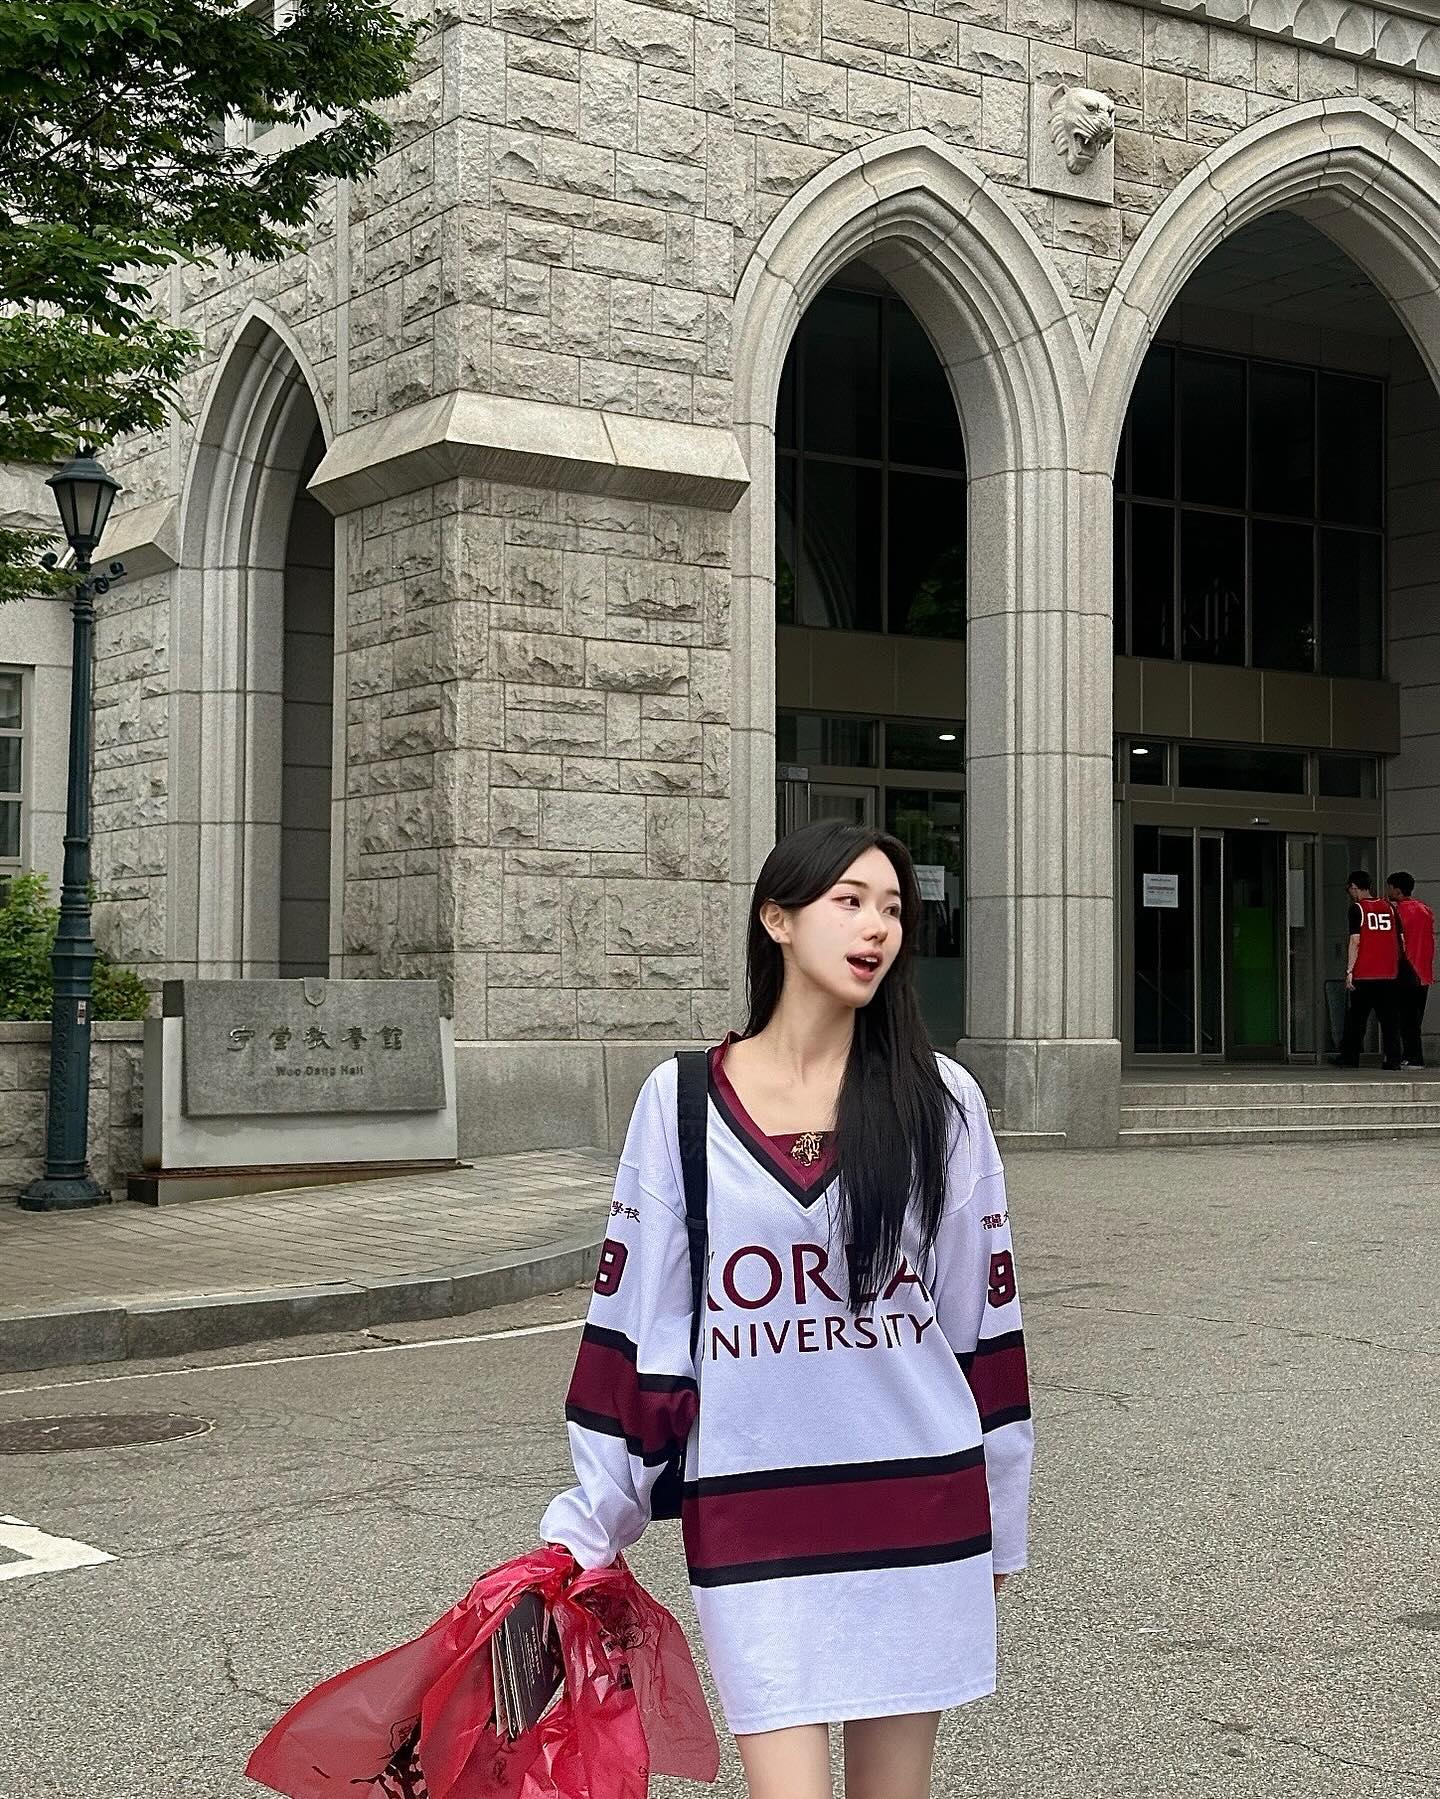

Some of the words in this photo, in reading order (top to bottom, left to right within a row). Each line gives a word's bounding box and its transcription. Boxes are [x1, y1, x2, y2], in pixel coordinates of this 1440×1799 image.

[1367, 912, 1392, 931] 05
[275, 1066, 301, 1077] Woo
[306, 1066, 337, 1077] Dang
[340, 1065, 364, 1076] Hall
[987, 1249, 1017, 1309] 9
